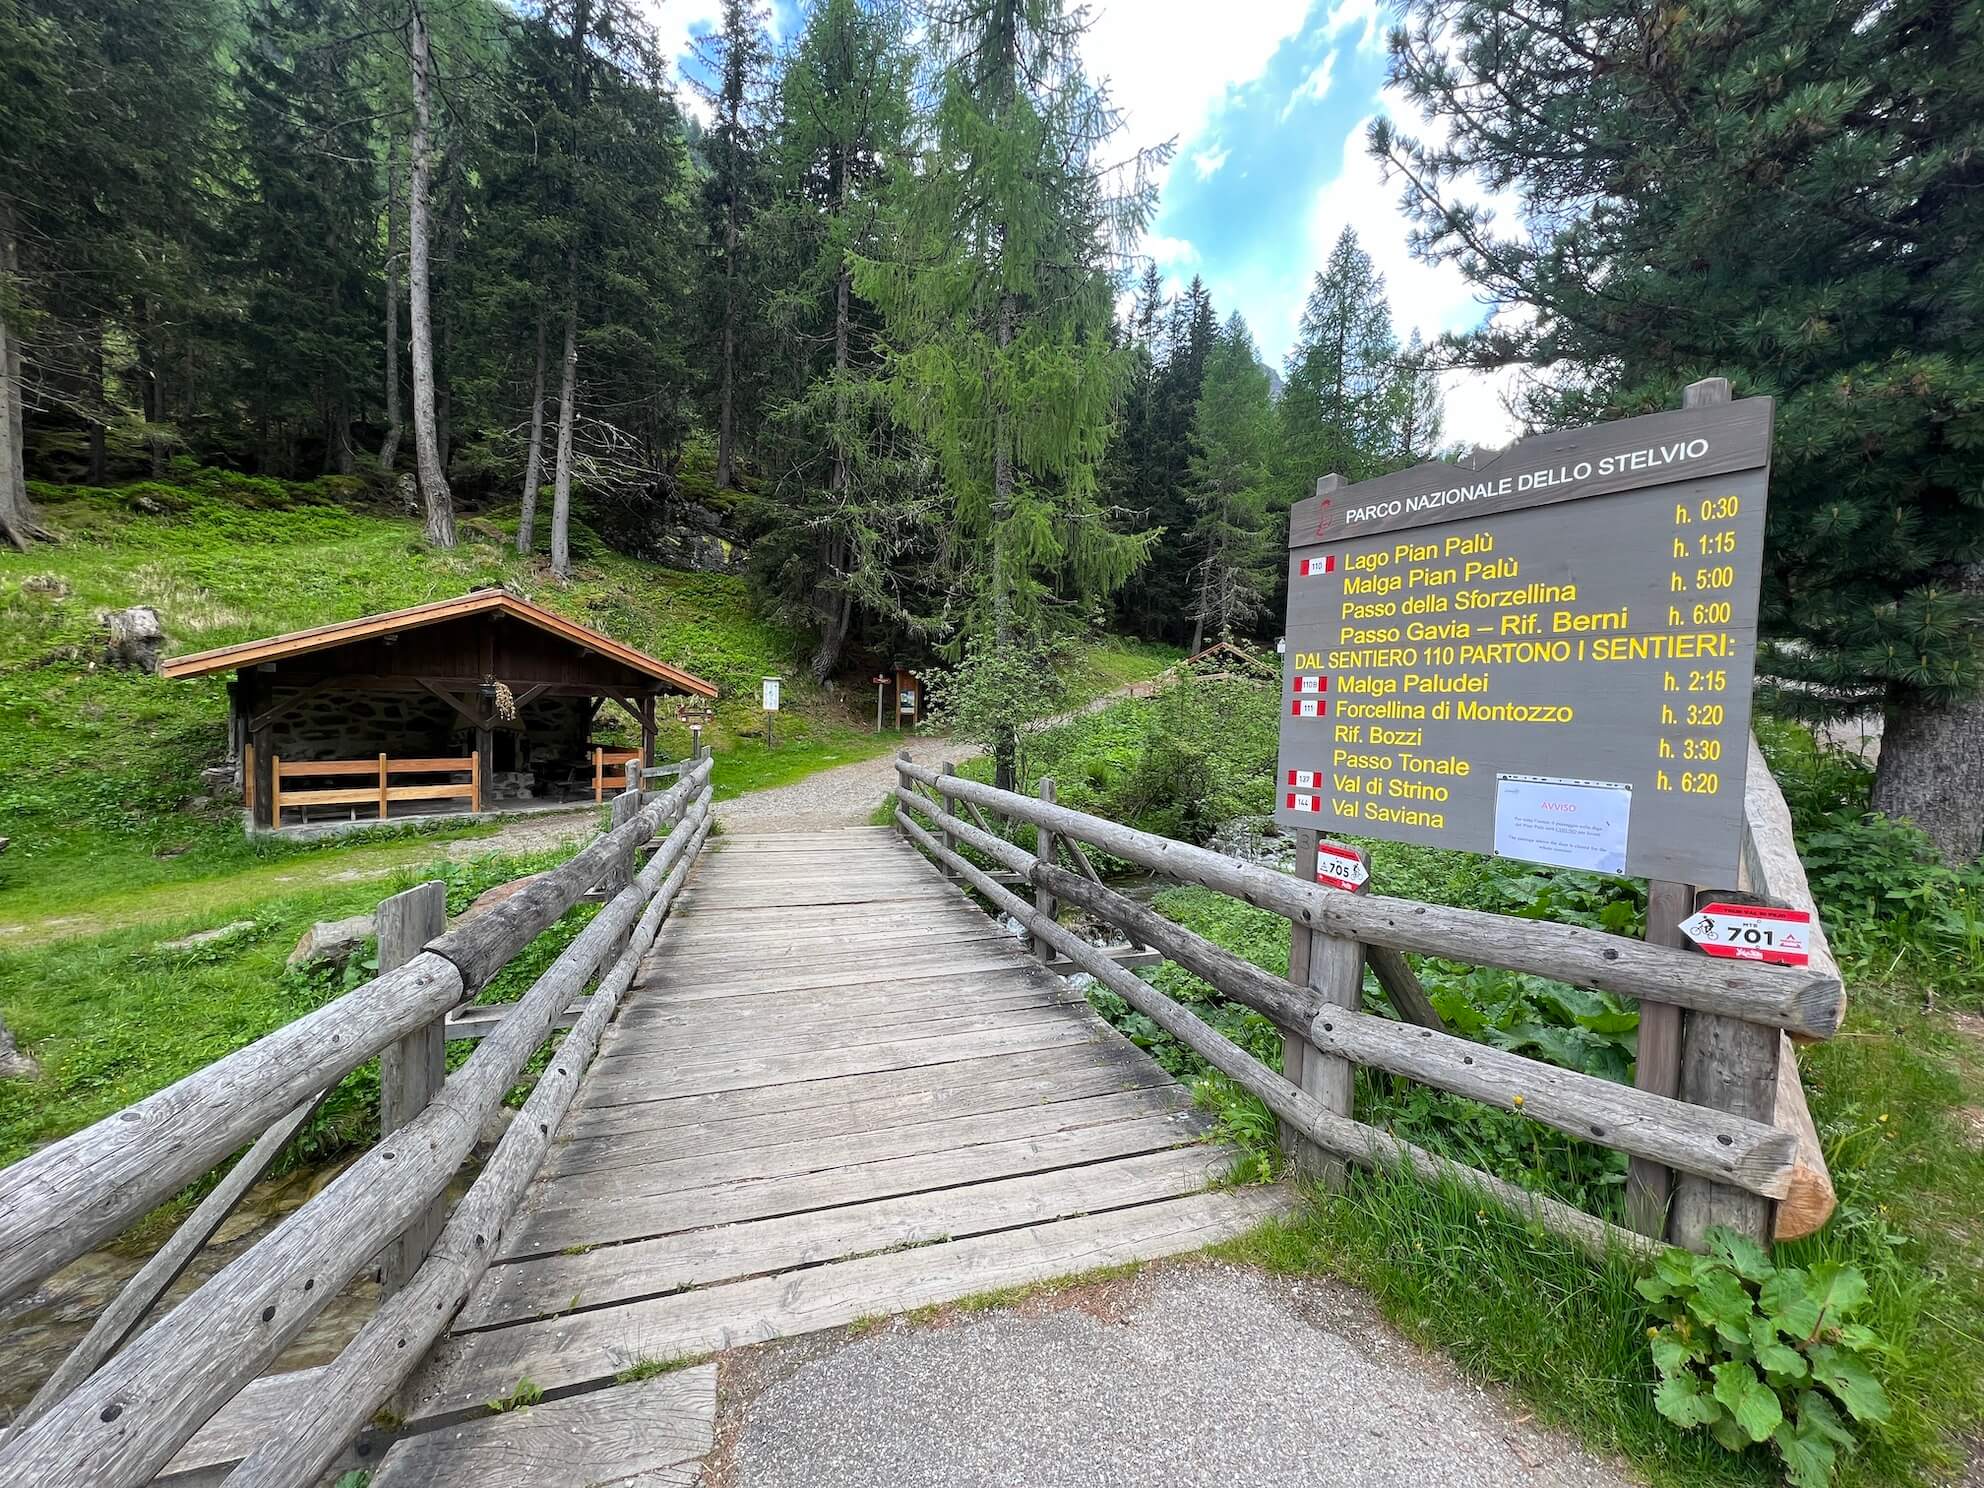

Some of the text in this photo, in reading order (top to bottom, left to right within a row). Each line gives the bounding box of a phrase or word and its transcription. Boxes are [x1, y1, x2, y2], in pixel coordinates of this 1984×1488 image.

[1345, 438, 1709, 525] PARCO NAZIONALE DELLO STELVIO
[1675, 495, 1739, 525] h. 0:30
[1344, 532, 1494, 573] Lago Pian Palù
[1673, 531, 1736, 558] h. 1:15
[1343, 557, 1519, 596] Malga Pian Palù
[1670, 565, 1734, 592] h. 5:00
[1341, 583, 1577, 620] Passo della Sforzellina
[1668, 601, 1732, 627] h. 6:00
[1339, 625, 1402, 646] Passo
[1406, 621, 1471, 642] Gavia
[1500, 612, 1544, 636] Rif.
[1551, 607, 1629, 635] Berni
[1294, 633, 1736, 670] DAL SENTIERO 110 PARTONO I SENTIERI:
[1337, 673, 1490, 697] Malga Paludei
[1663, 670, 1727, 692] h. 2:15
[1335, 699, 1574, 724] Forcellina di Montozzo
[1660, 703, 1725, 727] h. 3:20
[1334, 724, 1423, 747] Rif. Bozzi
[1333, 749, 1471, 777] Passo Tonale
[1658, 738, 1722, 762] h. 3:30
[1332, 773, 1450, 803] Val di Strino
[1656, 770, 1719, 796] h. 6:20
[1331, 798, 1445, 829] Val Saviana
[1541, 801, 1577, 812] AVVISO
[1329, 862, 1350, 878] 705
[1727, 926, 1773, 946] 701
